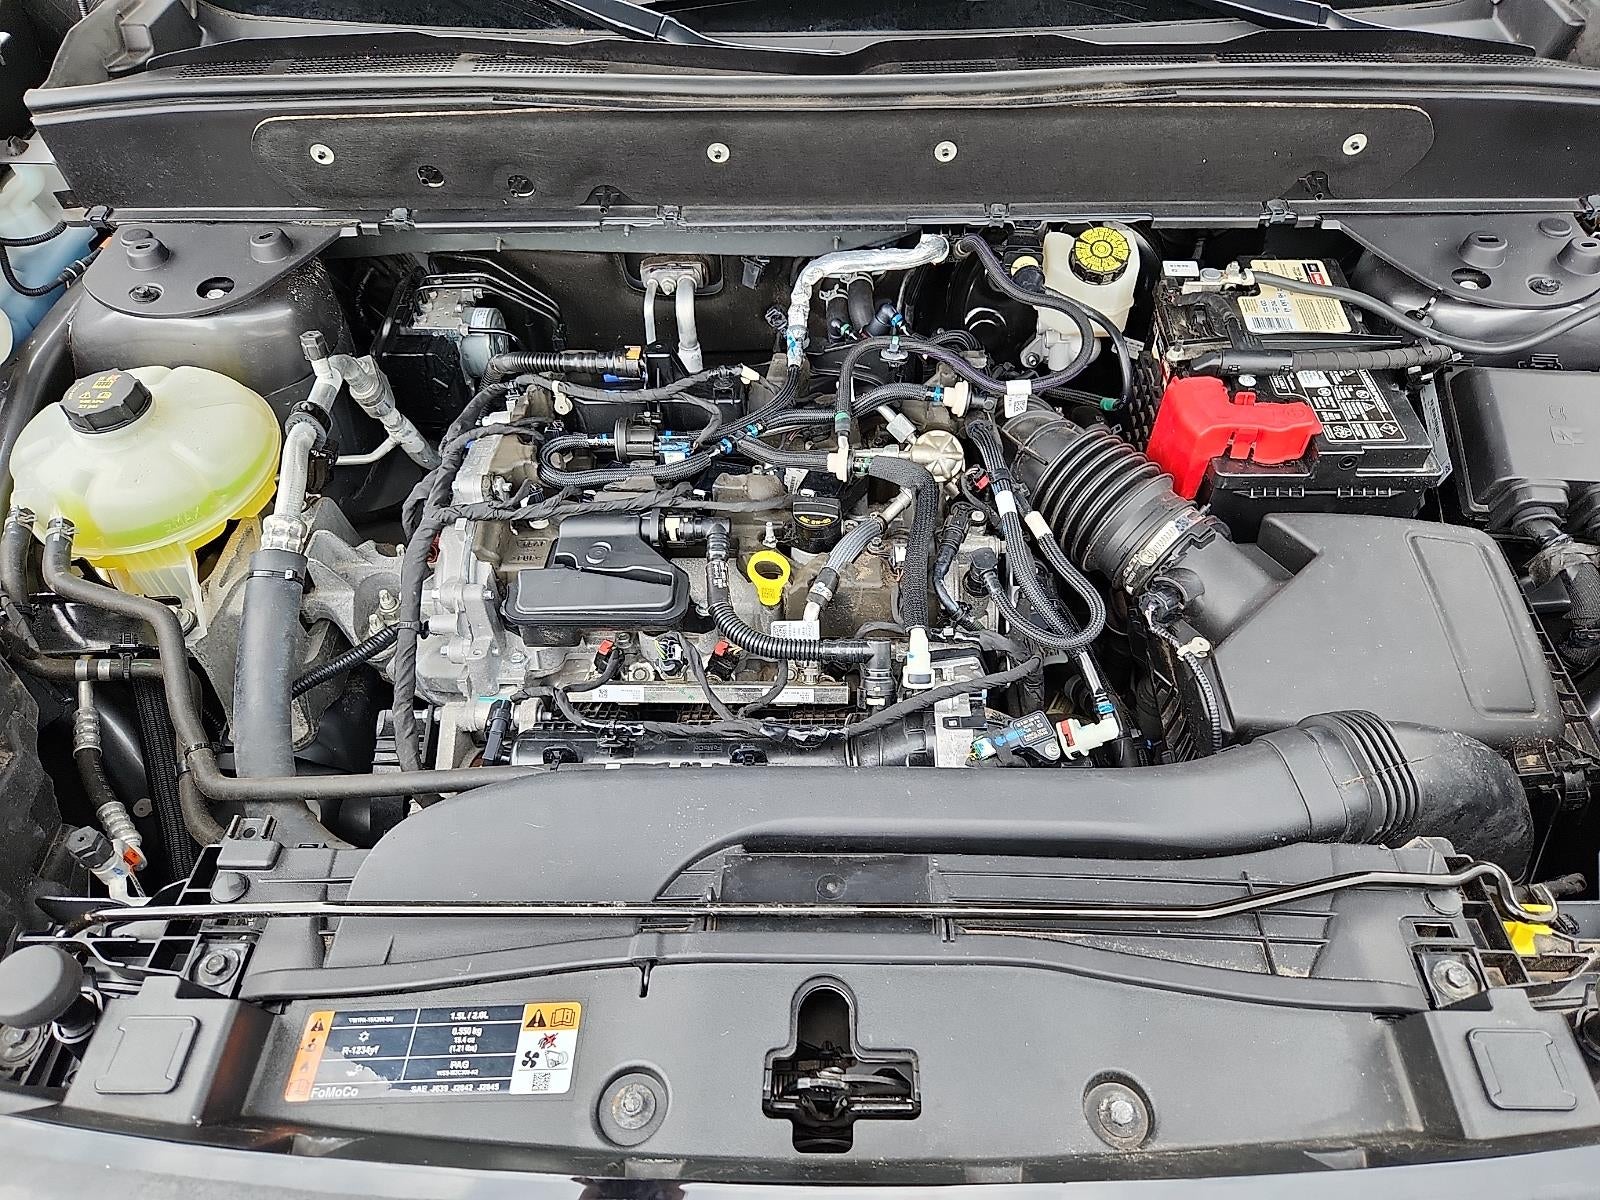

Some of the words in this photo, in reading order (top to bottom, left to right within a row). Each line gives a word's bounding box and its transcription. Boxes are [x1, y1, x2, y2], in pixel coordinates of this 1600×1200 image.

[471, 1010, 489, 1020] 2.0L
[451, 1026, 471, 1036] 0.550
[472, 1026, 483, 1037] kg
[341, 1045, 380, 1057] R-1234yf
[449, 1060, 470, 1069] PAG
[310, 1086, 359, 1098] FoMoCo
[409, 1084, 428, 1093] SAE
